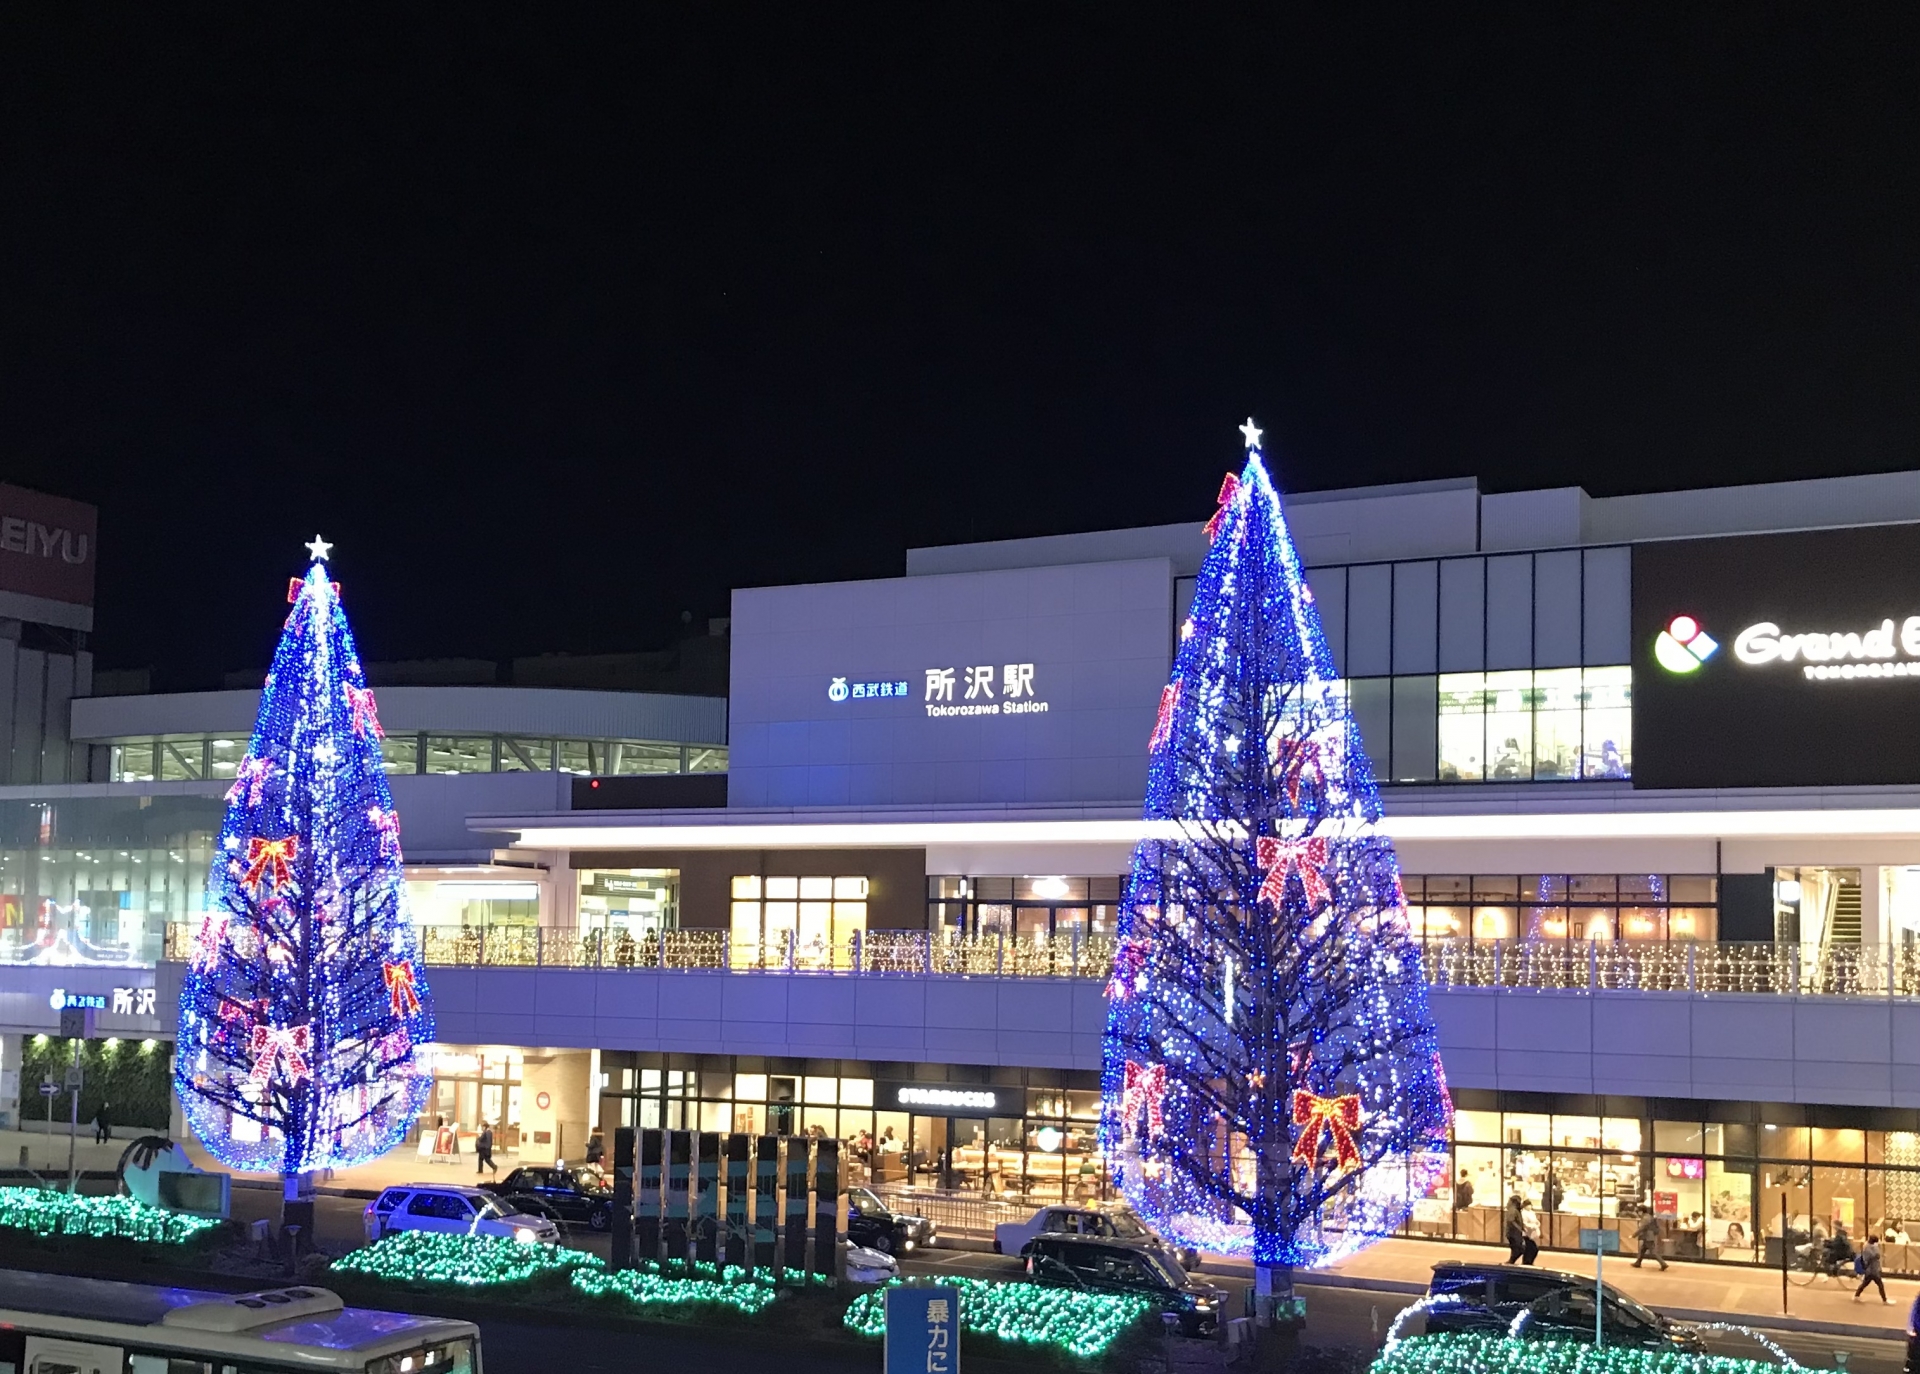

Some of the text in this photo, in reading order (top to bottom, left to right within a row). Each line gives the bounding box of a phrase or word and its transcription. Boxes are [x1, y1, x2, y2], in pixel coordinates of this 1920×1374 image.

[1734, 618, 1896, 665] Grand
[852, 663, 1035, 701] 西武鉄道 所沢駅
[925, 699, 1049, 718] Tokorozawa Station
[112, 987, 156, 1015] 所沢
[898, 1088, 996, 1108] STARBUCKS
[926, 1299, 949, 1373] 暴力に
